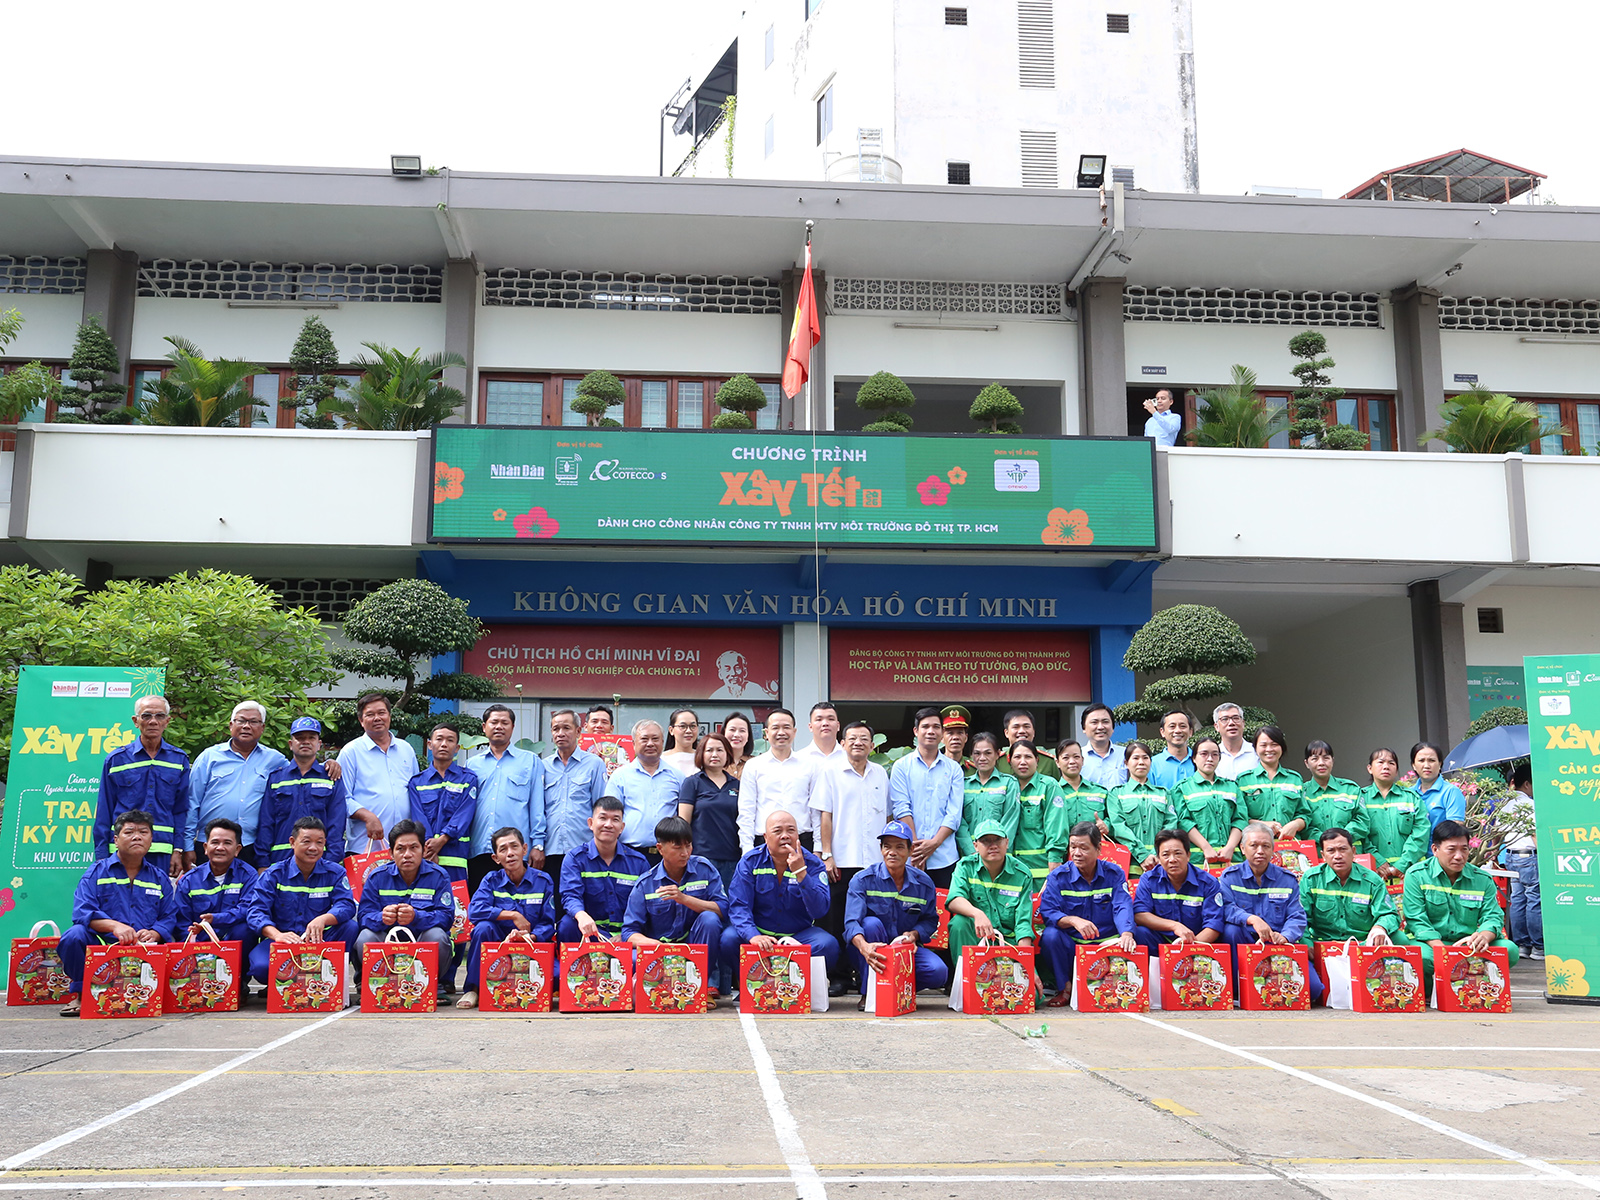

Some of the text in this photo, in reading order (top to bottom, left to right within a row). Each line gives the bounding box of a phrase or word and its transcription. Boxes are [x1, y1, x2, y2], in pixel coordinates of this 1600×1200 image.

[731, 446, 867, 462] CHƯƠNG TRÌNH
[490, 464, 544, 477] Nhân Dân
[718, 466, 861, 517] Xây Tết
[598, 517, 999, 534] DÀNH CHO CÔNG NHÂN CÔNG TY TNHH MTV MÔI TRƯỜNG ĐÔ THỊ TP. HCM
[513, 586, 1058, 618] KHÔNG GIAN VĂN HÓA HỒ CHÍ MINH
[487, 644, 700, 664] CHỦ TỊCH HỒ CHÍ MINH VĨ ĐẠI
[850, 650, 871, 658] ĐẢNG
[872, 650, 882, 658] BỘ
[884, 650, 905, 658] CÔNG
[956, 650, 970, 658] MÔI
[972, 650, 1002, 658] TRƯỜNG
[1003, 650, 1014, 658] ĐÔ
[1016, 651, 1028, 660] THỊ
[1028, 650, 1054, 658] THÀNH
[1055, 650, 1070, 658] PHỐ
[486, 664, 514, 675] SỐNG
[516, 665, 535, 674] MÃI
[536, 666, 570, 675] TRONG
[572, 666, 585, 677] SỰ
[588, 666, 624, 677] NGHIỆP
[626, 664, 645, 676] CỦA
[648, 665, 682, 676] CHÚNG
[684, 668, 696, 676] TA
[849, 660, 1072, 672] HỌC TẬP VÀ LÀM THEO TƯ TƯỞNG, ĐẠO ĐỨC,
[894, 672, 1028, 684] PHONG CÁCH HỒ CHÍ MINH
[18, 722, 136, 762] Xây Tết
[1544, 723, 1600, 756] Xây
[1558, 762, 1588, 775] CẢM
[44, 800, 97, 822] TRẠ
[22, 818, 58, 844] KỶ
[34, 851, 94, 864] KHU VỰC IN
[1557, 849, 1593, 873] KỶ
